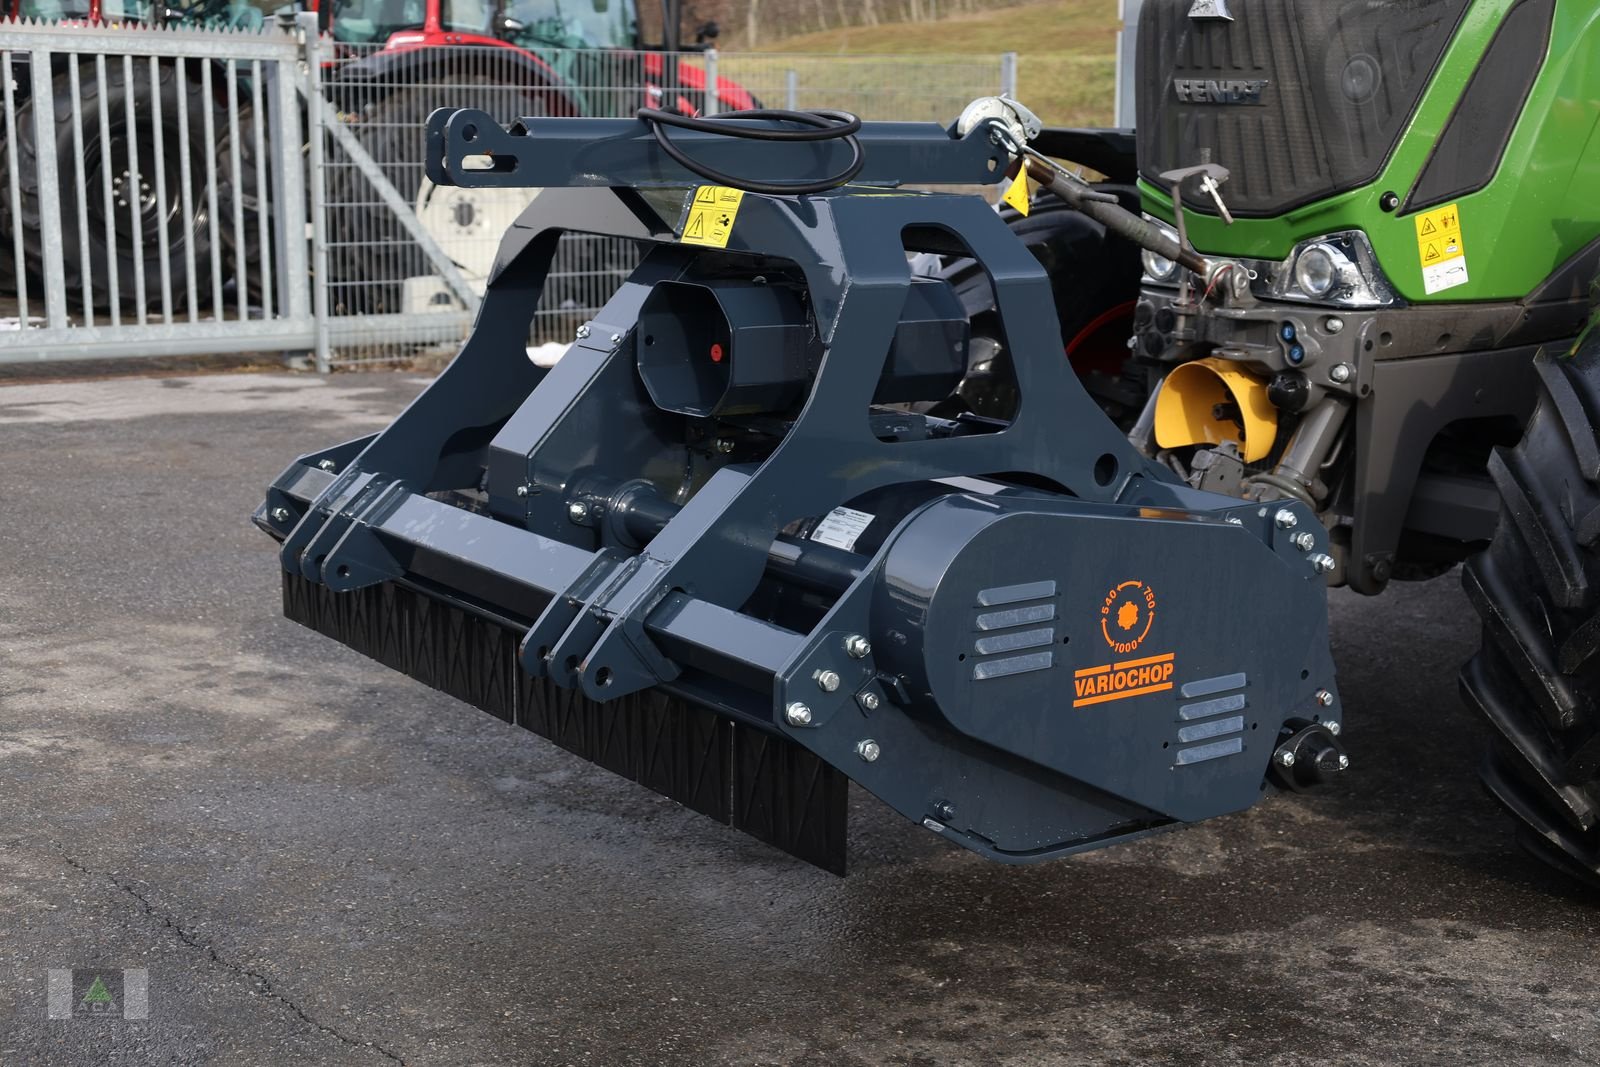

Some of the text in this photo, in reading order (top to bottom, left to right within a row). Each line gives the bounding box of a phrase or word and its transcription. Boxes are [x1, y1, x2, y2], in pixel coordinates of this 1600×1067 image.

[1101, 589, 1117, 615] 540
[1143, 586, 1156, 609] 750
[1114, 640, 1138, 653] 1000
[1074, 662, 1174, 697] VARIOCHOP
